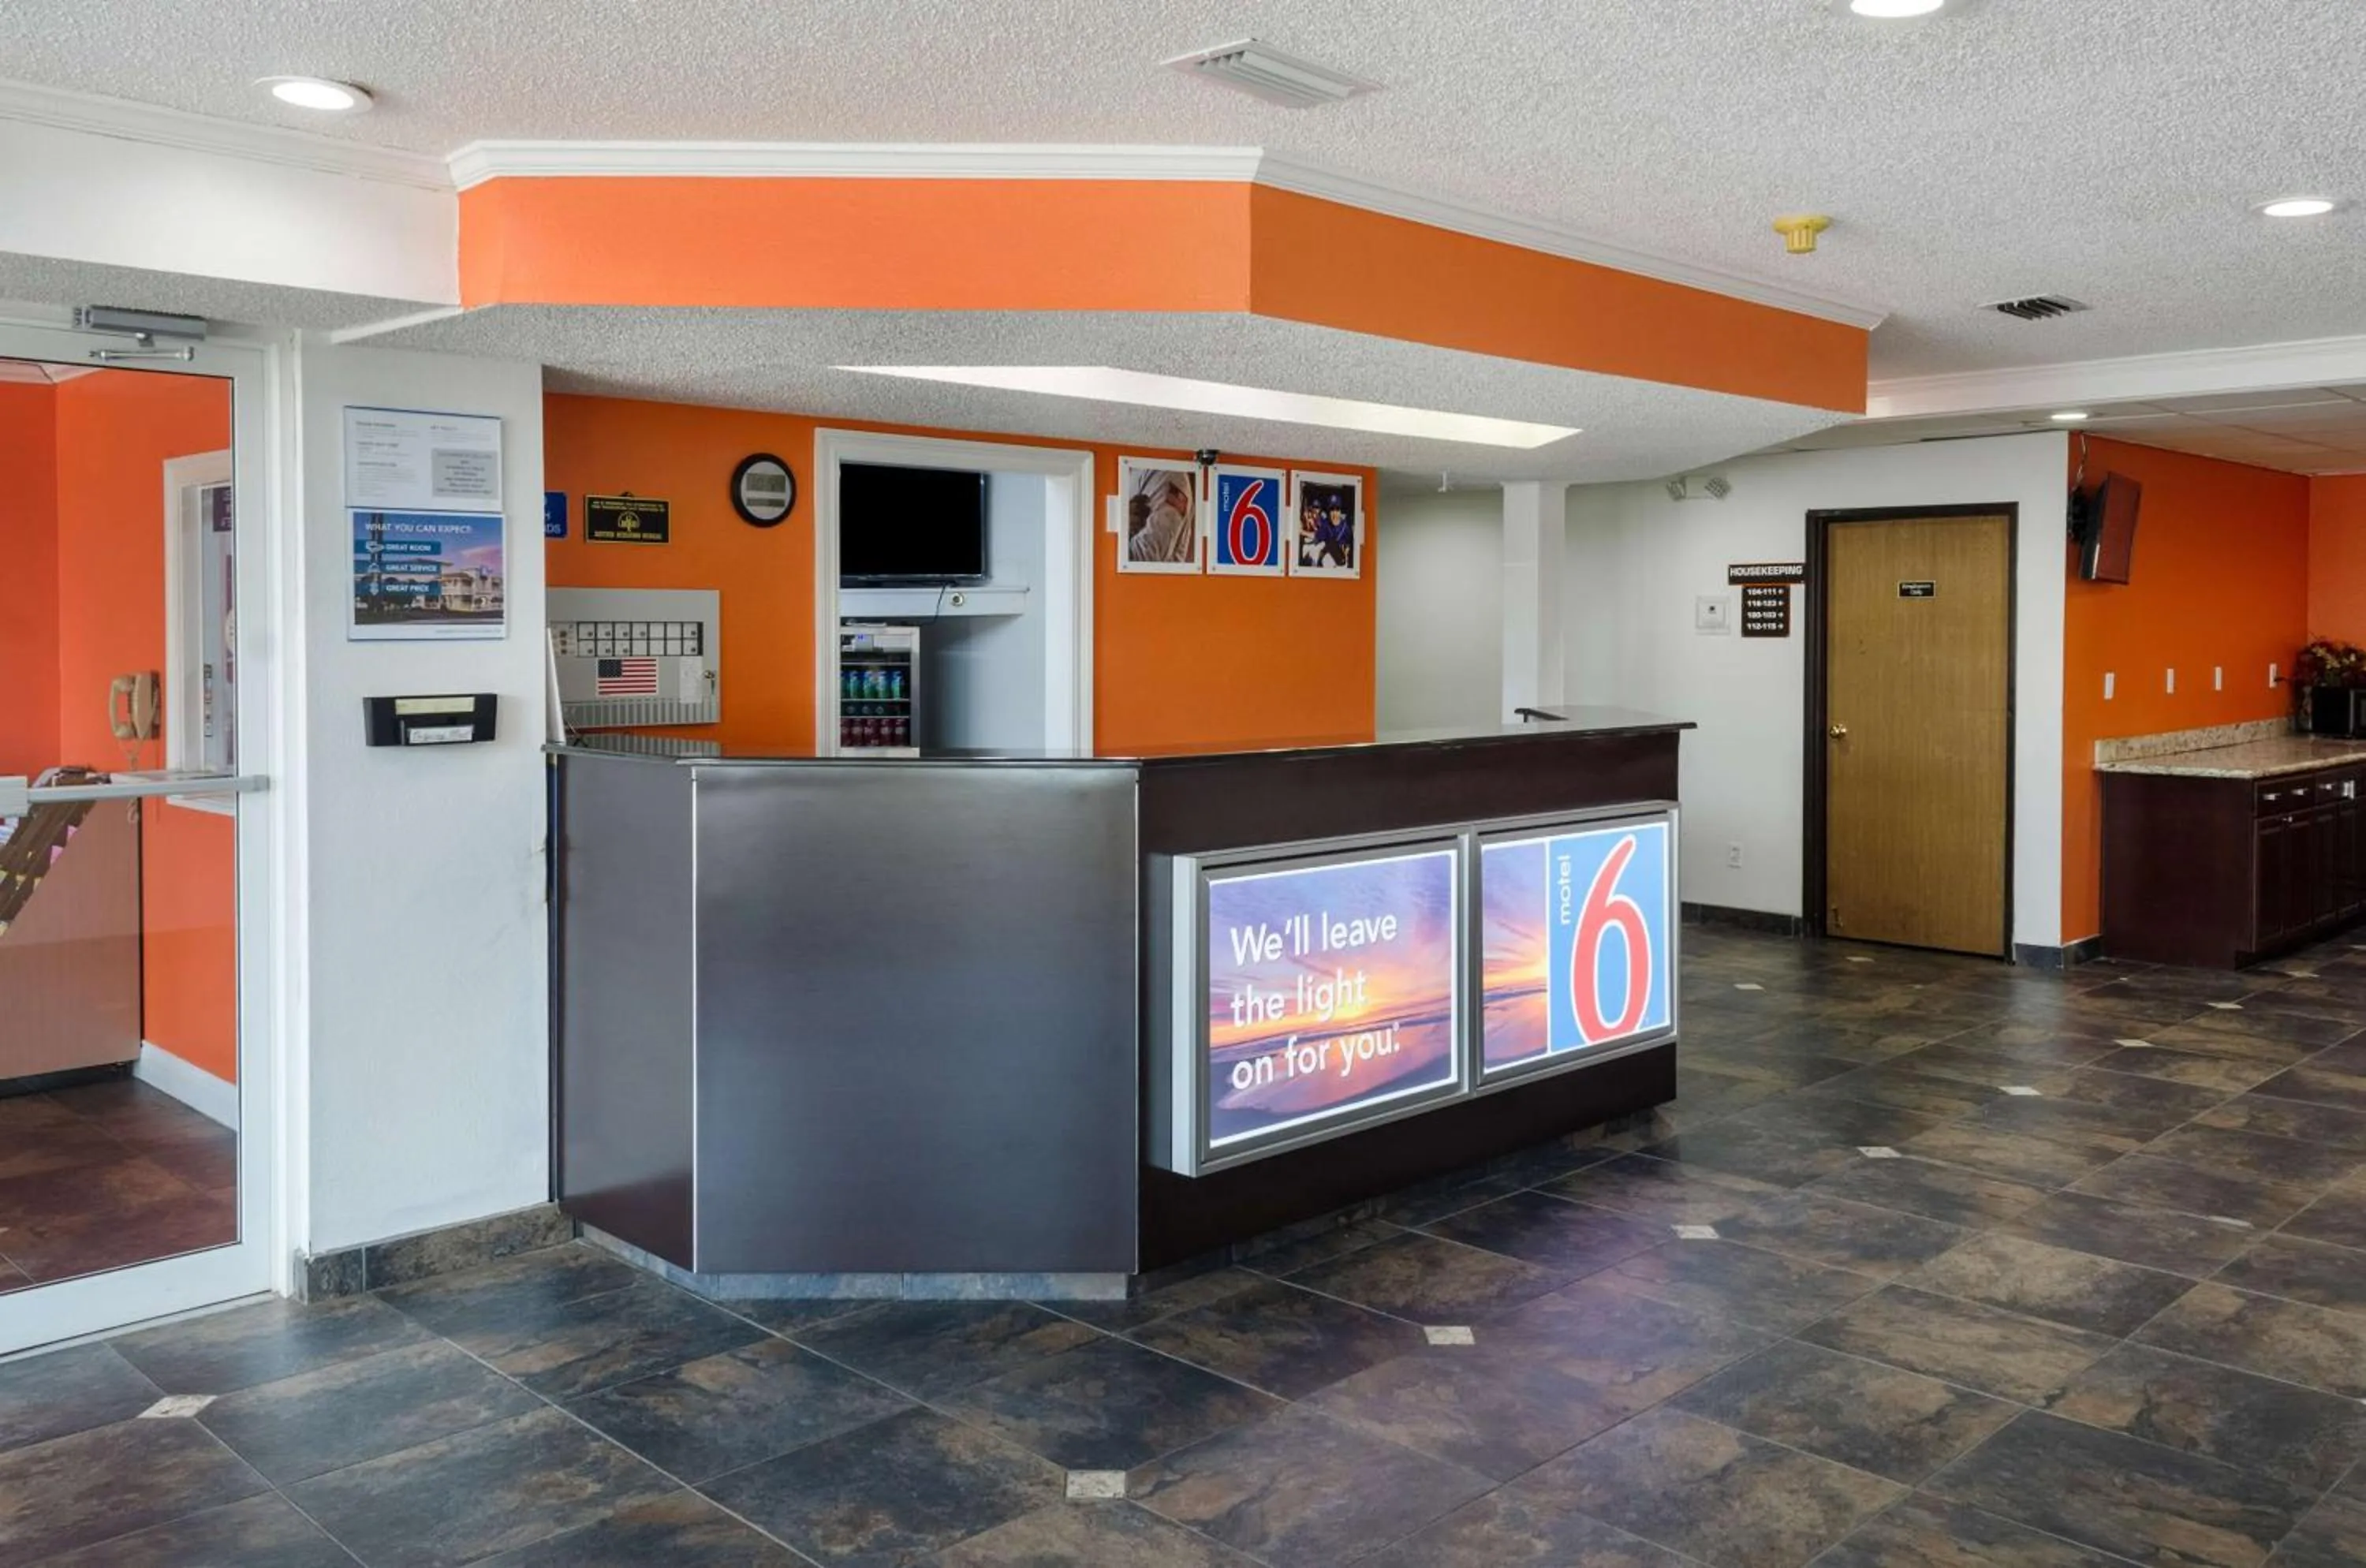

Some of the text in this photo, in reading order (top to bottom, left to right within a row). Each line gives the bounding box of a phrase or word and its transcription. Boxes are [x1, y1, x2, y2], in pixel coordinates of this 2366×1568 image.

[364, 523, 391, 532] WHAT
[394, 524, 413, 532] YOU
[416, 525, 436, 533] CAN
[544, 524, 562, 535] DS
[1227, 479, 1272, 566] 6
[1730, 565, 1803, 577] HOUSEKEEPING
[1230, 911, 1398, 967] We'll leave
[1556, 833, 1652, 1045] motel 6
[1230, 968, 1367, 1029] the light
[1232, 1054, 1274, 1090] on
[1285, 1035, 1331, 1078] for
